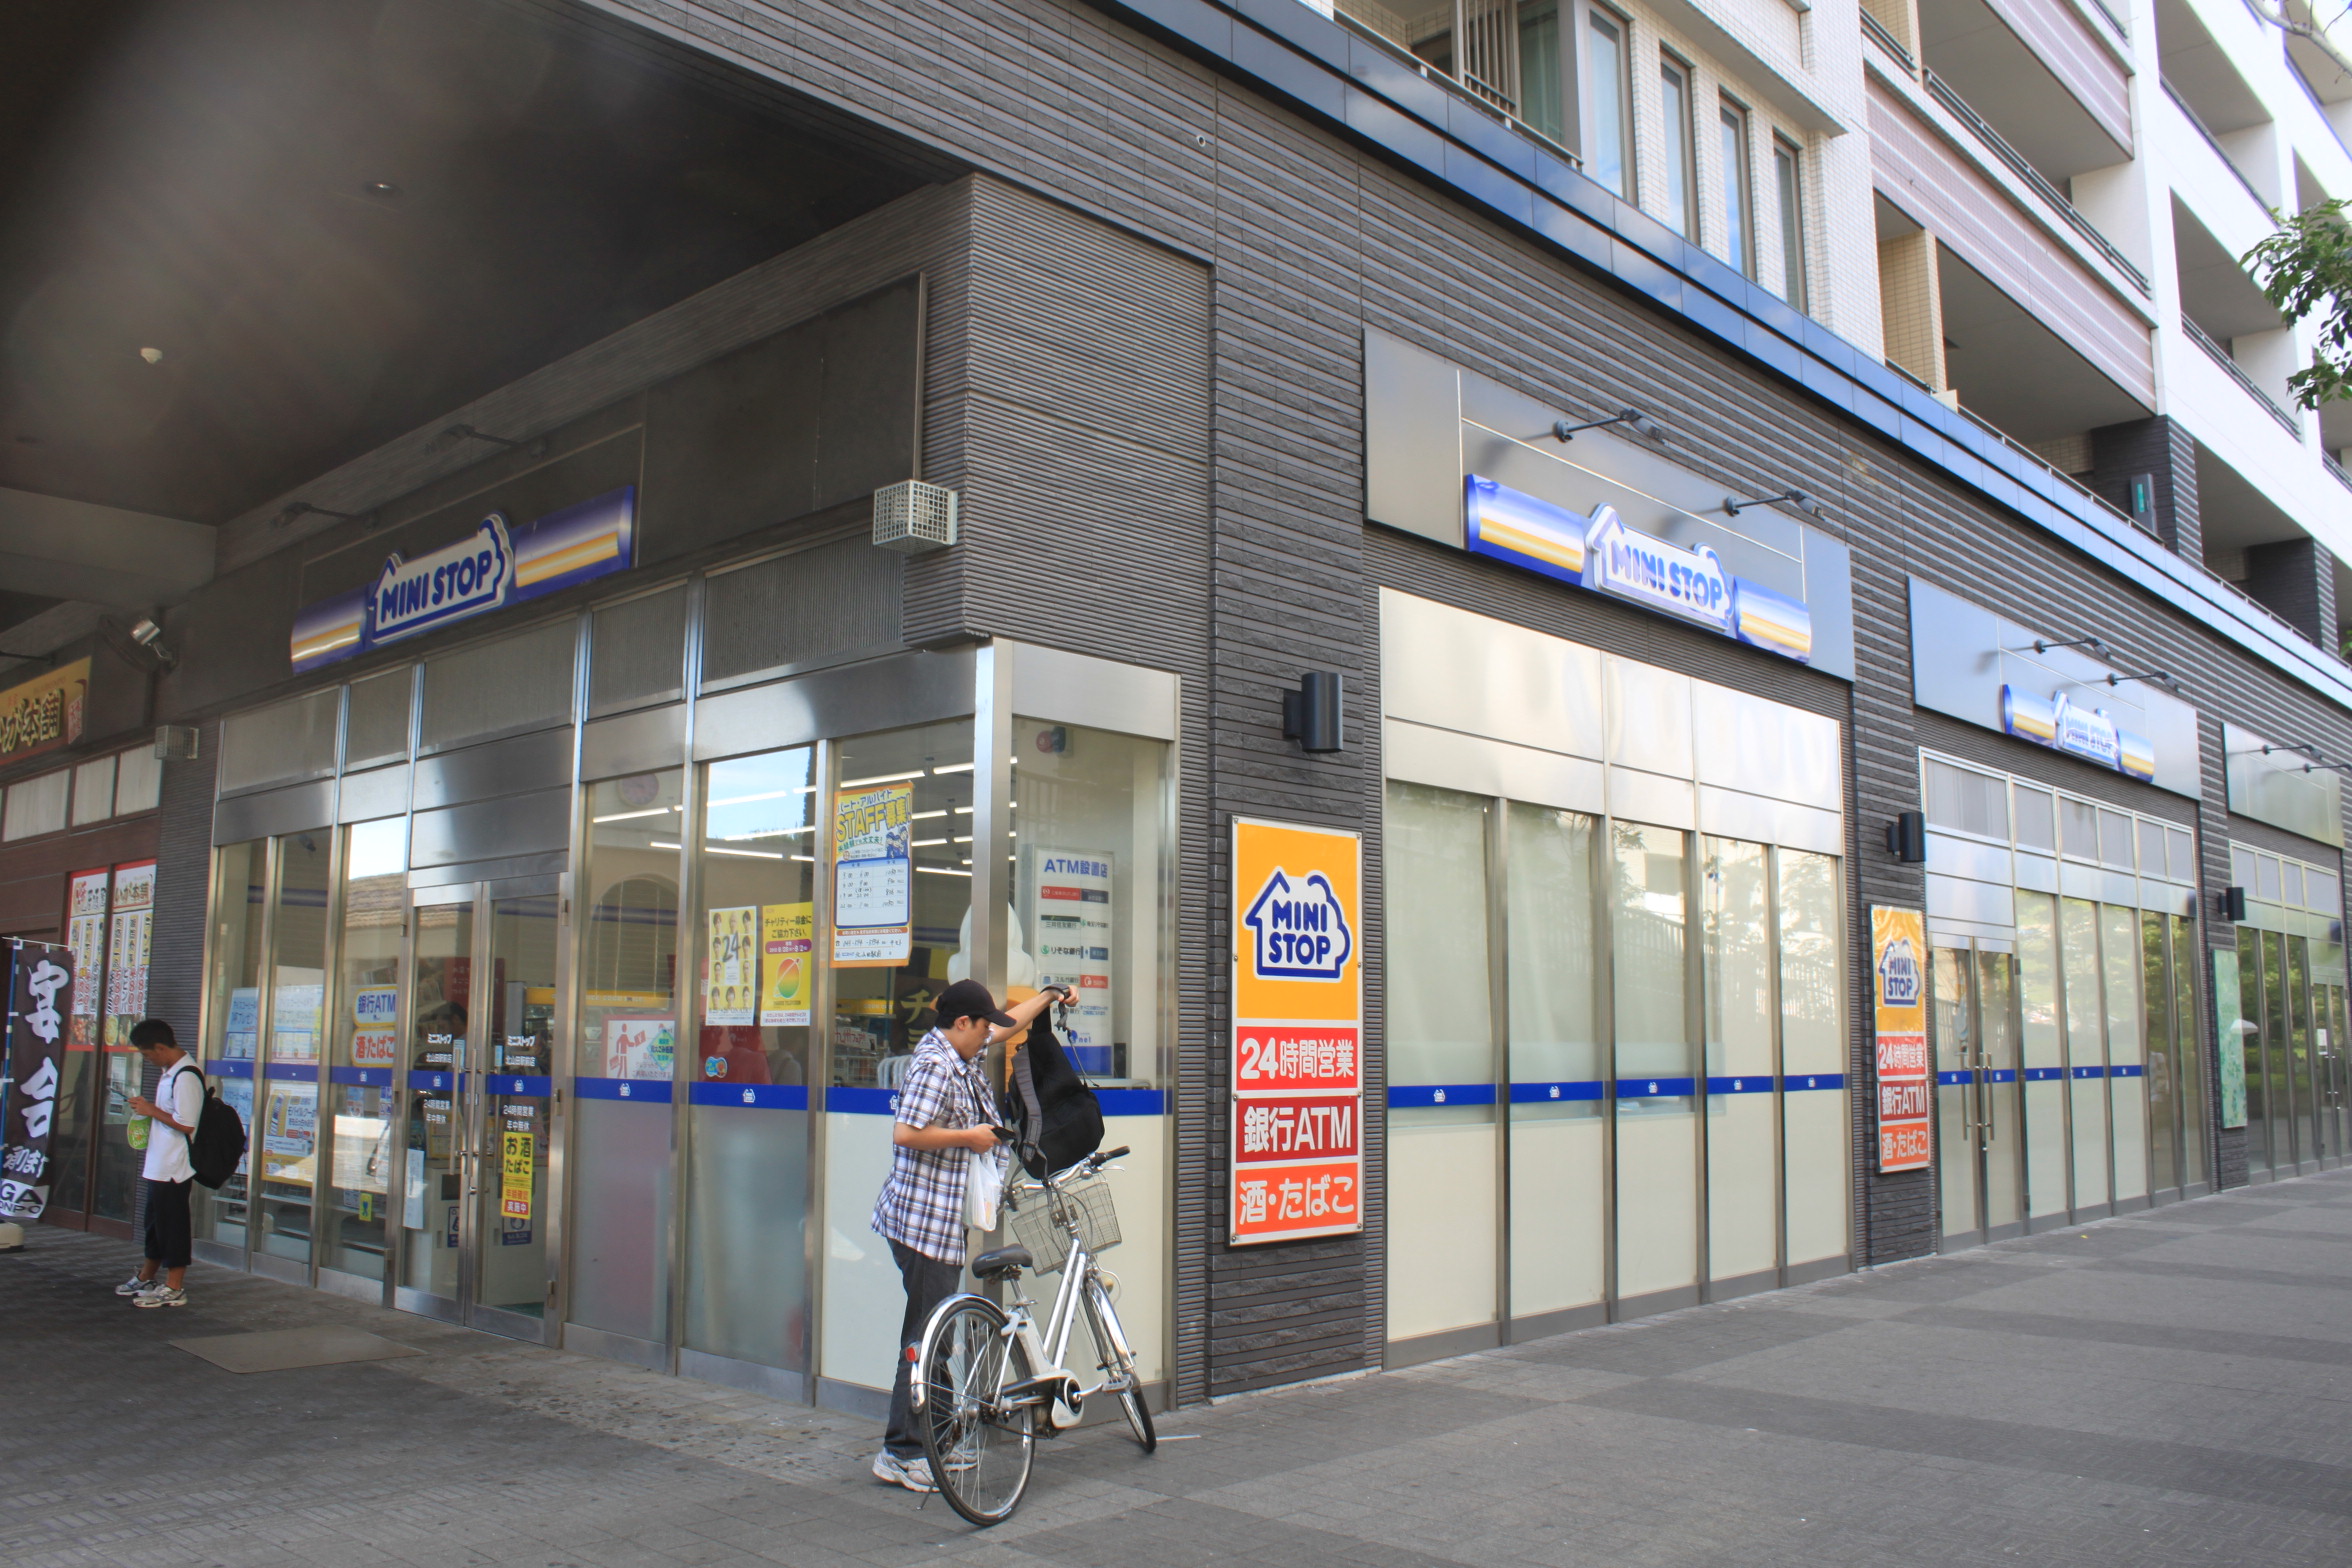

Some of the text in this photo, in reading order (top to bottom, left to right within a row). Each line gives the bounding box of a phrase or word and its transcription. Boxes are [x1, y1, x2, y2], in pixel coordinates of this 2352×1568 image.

[381, 550, 492, 623] MINI STOP
[1611, 538, 1722, 611] MINI STOP
[1044, 858, 1108, 879] ATM設置店
[1272, 899, 1328, 933] MINI
[722, 930, 742, 962] 24
[1051, 947, 1081, 955] りそな銀行
[1269, 931, 1331, 965] STOP
[1888, 956, 1911, 976] MINI
[1888, 974, 1913, 998] STOP
[358, 993, 396, 1014] 銀行ATM
[428, 1033, 453, 1044] ミニストップ
[507, 1035, 536, 1047] ミニストップ
[1240, 1037, 1355, 1080] 24時間営業
[1878, 1042, 1925, 1070] 24時間営業
[503, 1104, 534, 1117] 24時間営業
[1882, 1084, 1926, 1116] 銀行ATM
[507, 1119, 530, 1132] 年中無休
[1244, 1105, 1351, 1153] 銀行ATM
[1881, 1130, 1927, 1161] 酒・たばこ
[505, 1158, 530, 1175] たばこ
[507, 1200, 527, 1213] 実施中
[1239, 1173, 1355, 1225] 酒・たばこ
